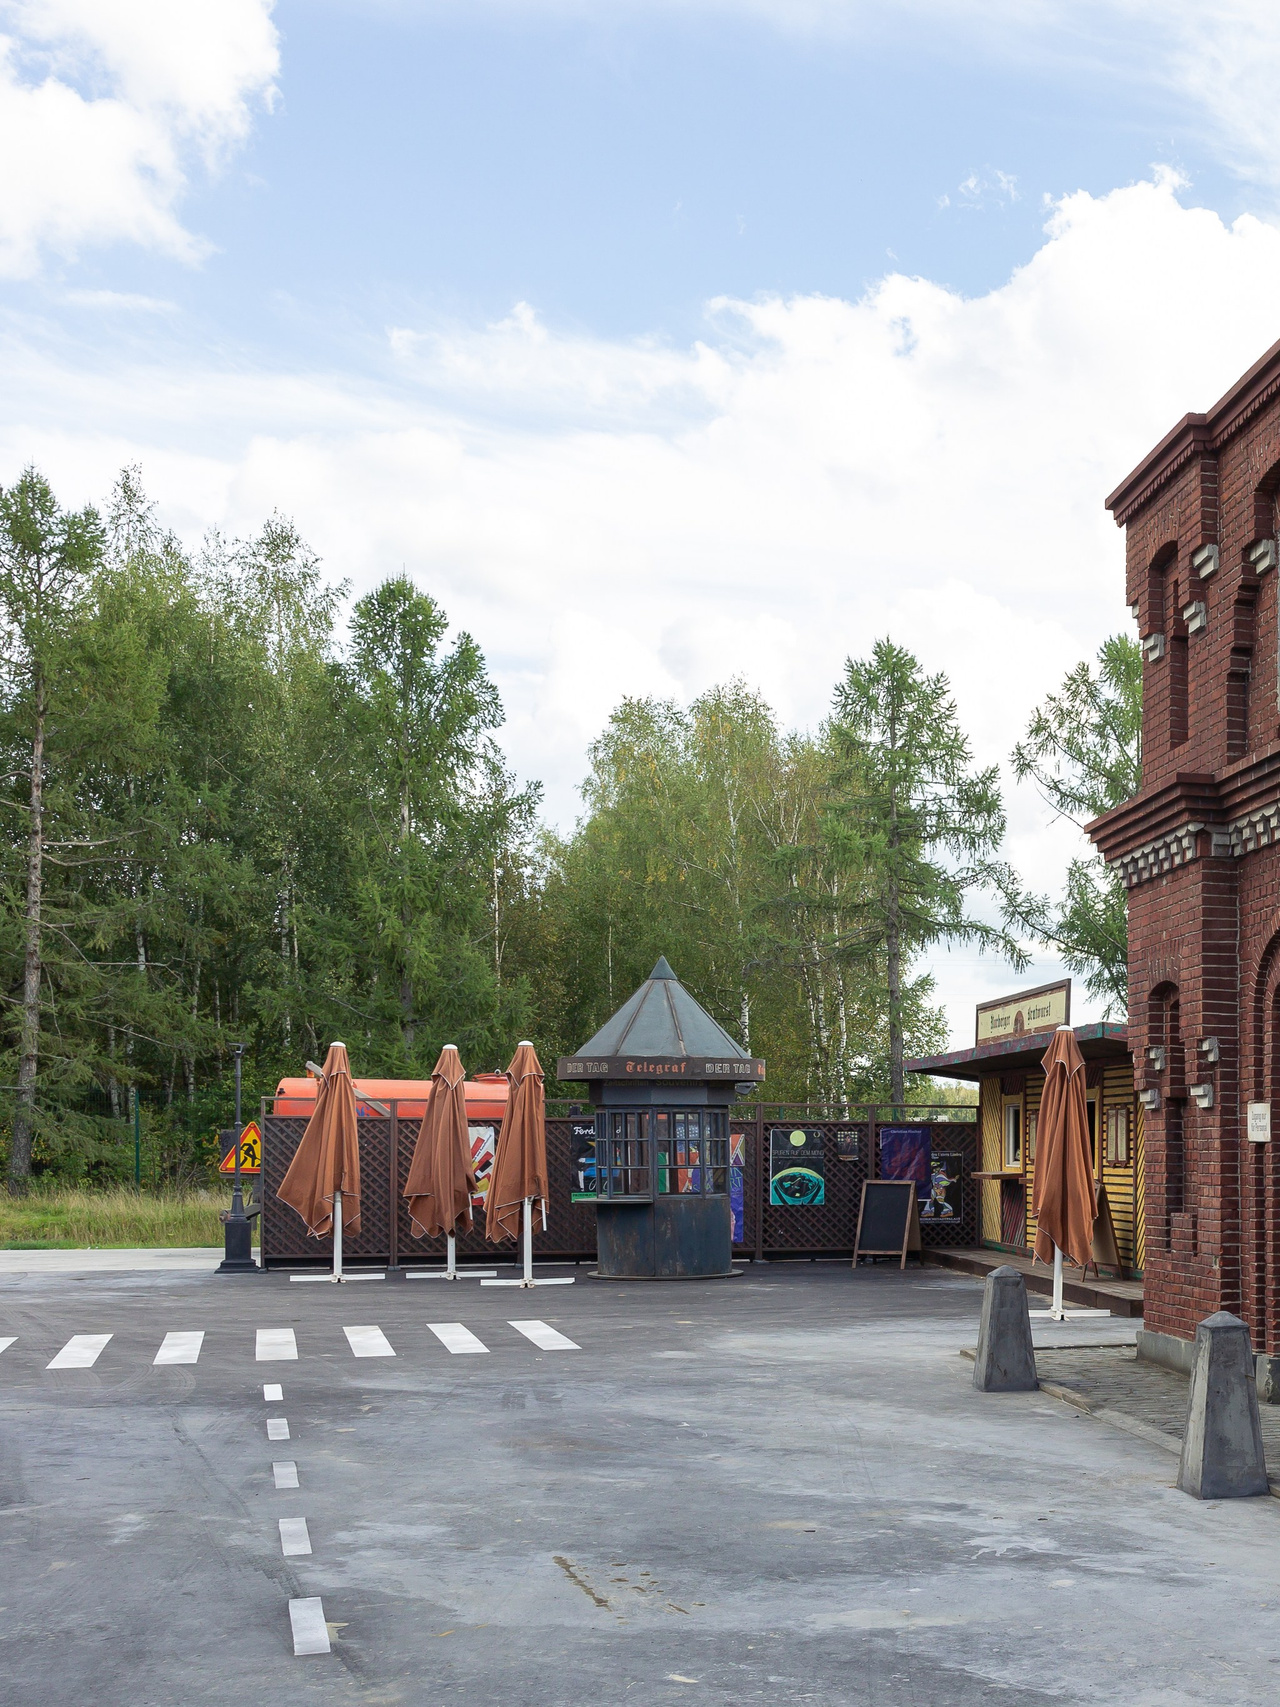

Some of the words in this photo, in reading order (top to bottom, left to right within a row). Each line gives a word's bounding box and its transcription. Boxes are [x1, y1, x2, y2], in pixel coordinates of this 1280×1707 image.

[566, 1062, 584, 1073] DER
[586, 1062, 608, 1073] TAG
[626, 1060, 687, 1075] Telegraf
[705, 1063, 730, 1074] DER
[733, 1063, 751, 1074] TAG
